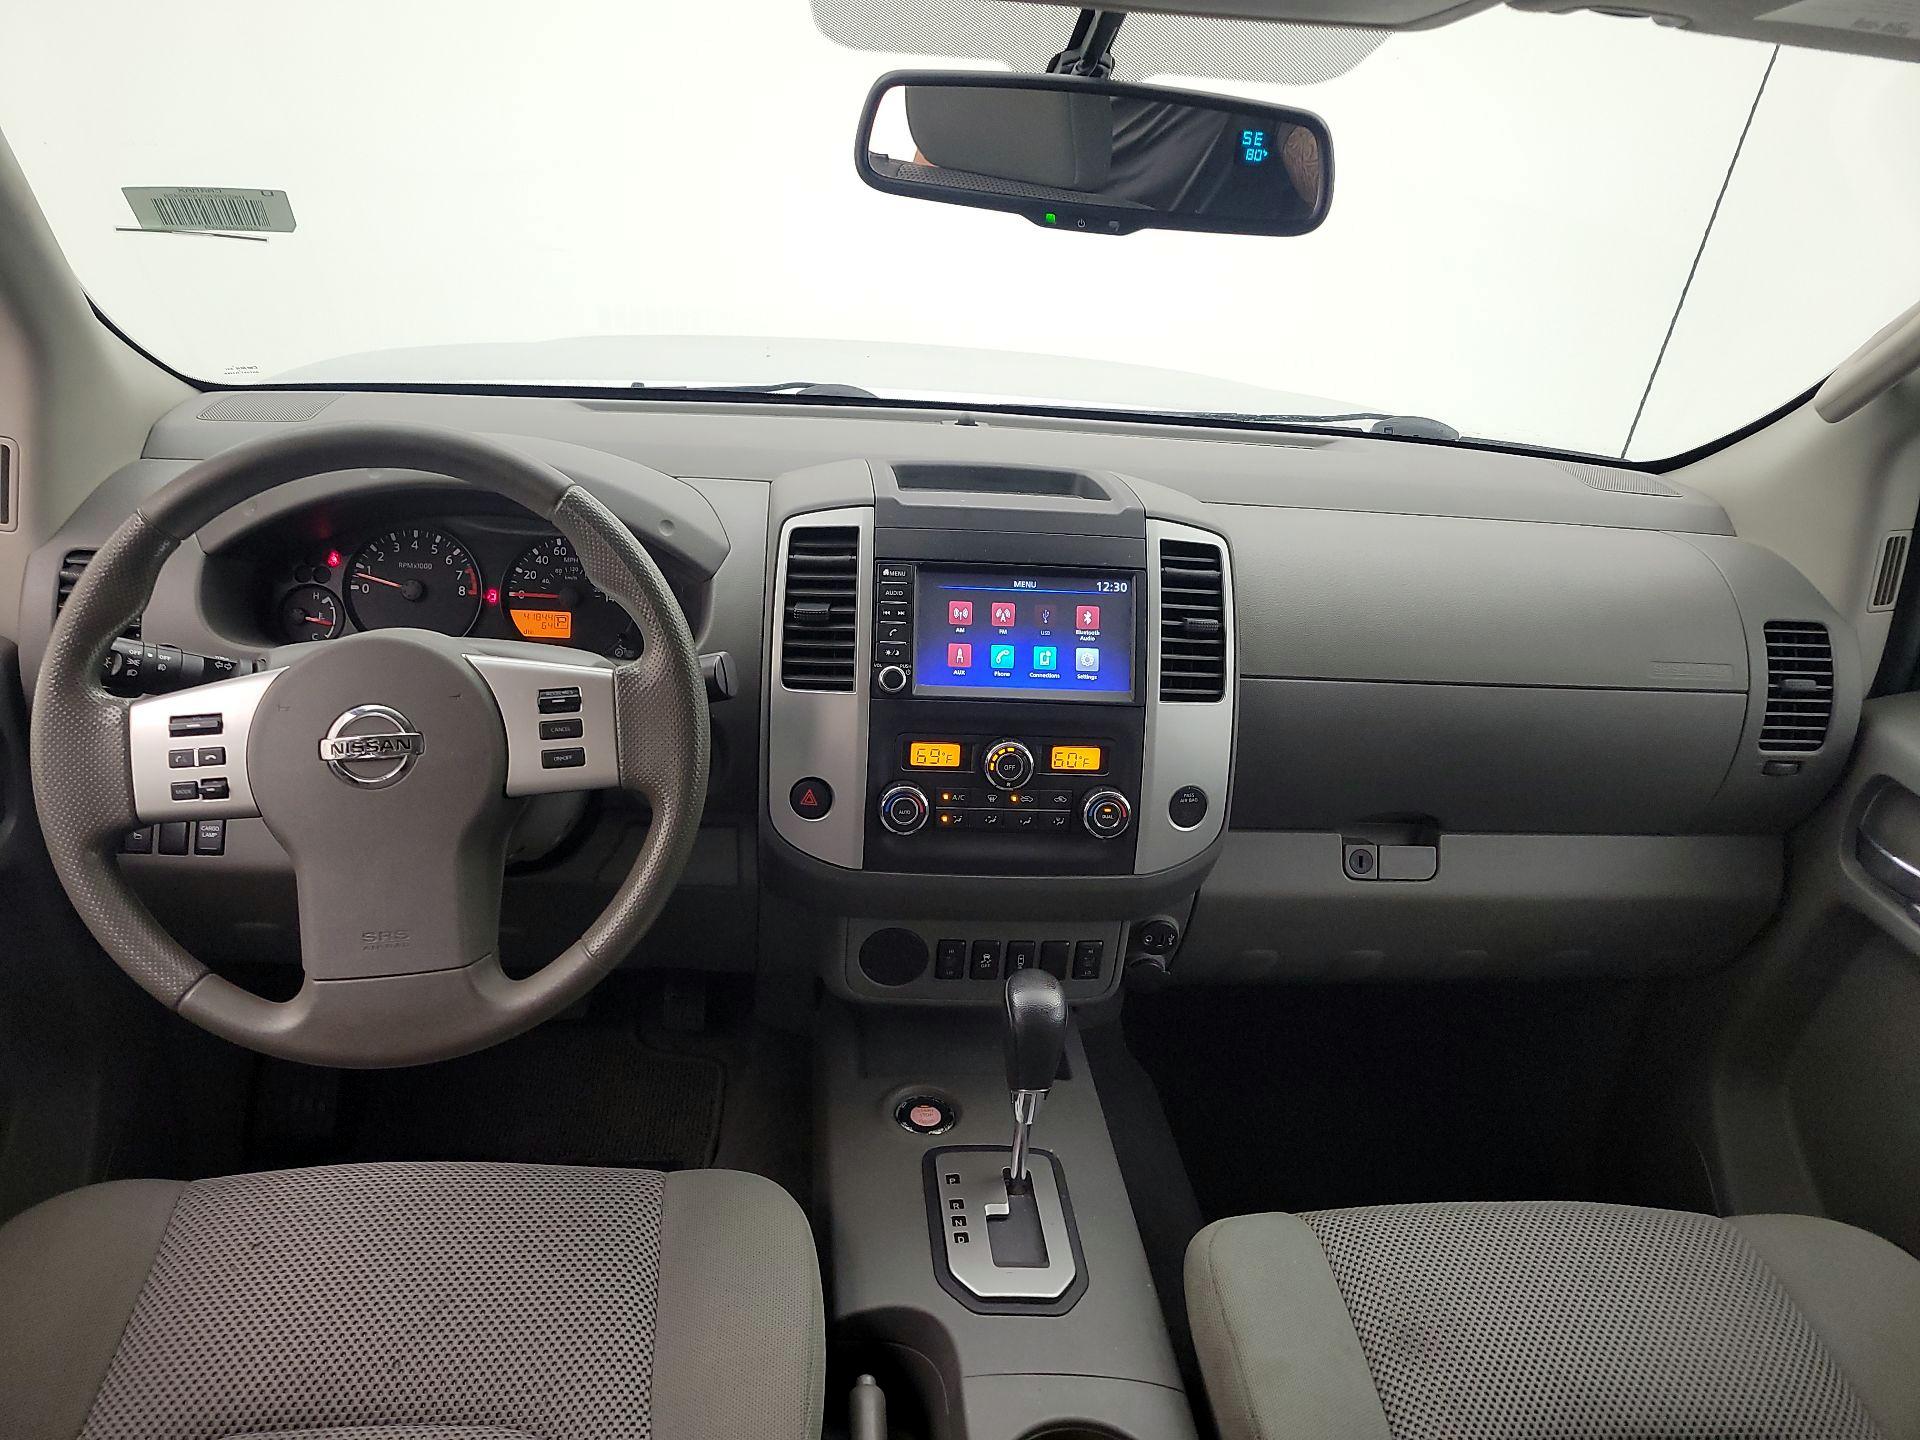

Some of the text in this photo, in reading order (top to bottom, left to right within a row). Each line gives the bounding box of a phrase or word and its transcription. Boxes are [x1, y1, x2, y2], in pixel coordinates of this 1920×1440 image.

[1242, 131, 1264, 147] SE
[393, 542, 400, 552] 3
[411, 540, 419, 550] 4
[431, 544, 438, 554] 5
[553, 546, 567, 556] 60
[377, 552, 385, 562] 2
[445, 555, 453, 565] 6
[535, 555, 549, 565] 40
[455, 570, 463, 580] 7
[523, 570, 537, 580] 20
[361, 583, 370, 593] 0
[458, 585, 466, 596] 8
[1096, 581, 1128, 592] 12:30
[312, 592, 320, 600] H
[330, 739, 411, 756] NISSAN
[952, 1202, 960, 1210] R
[957, 1236, 964, 1244] D
